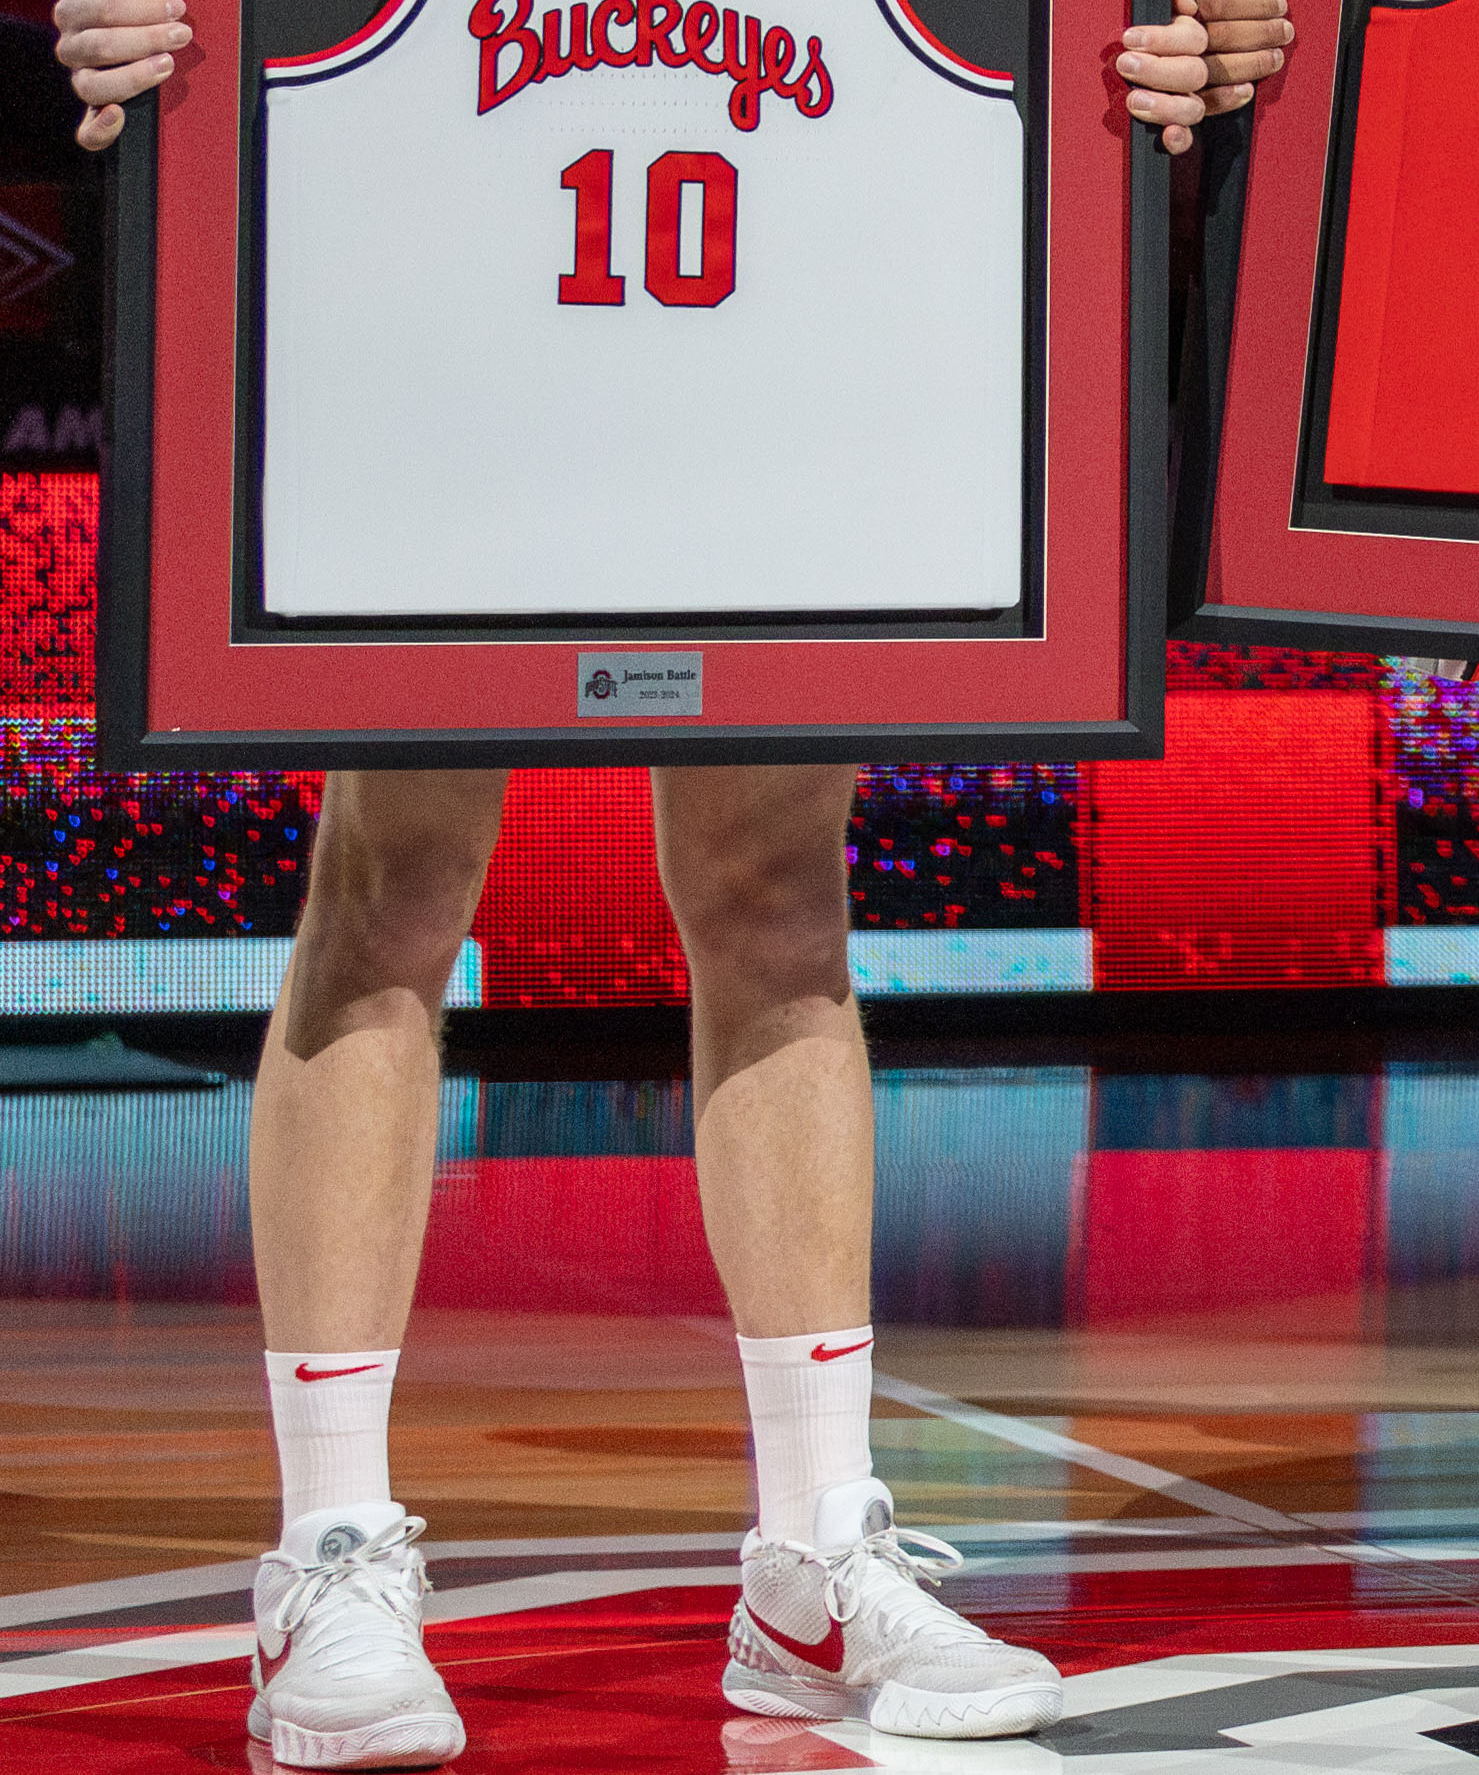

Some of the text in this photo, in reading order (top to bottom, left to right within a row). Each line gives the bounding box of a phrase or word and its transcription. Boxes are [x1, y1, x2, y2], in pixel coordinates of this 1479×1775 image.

[557, 148, 738, 308] 10
[622, 669, 696, 684] Jamison Battle
